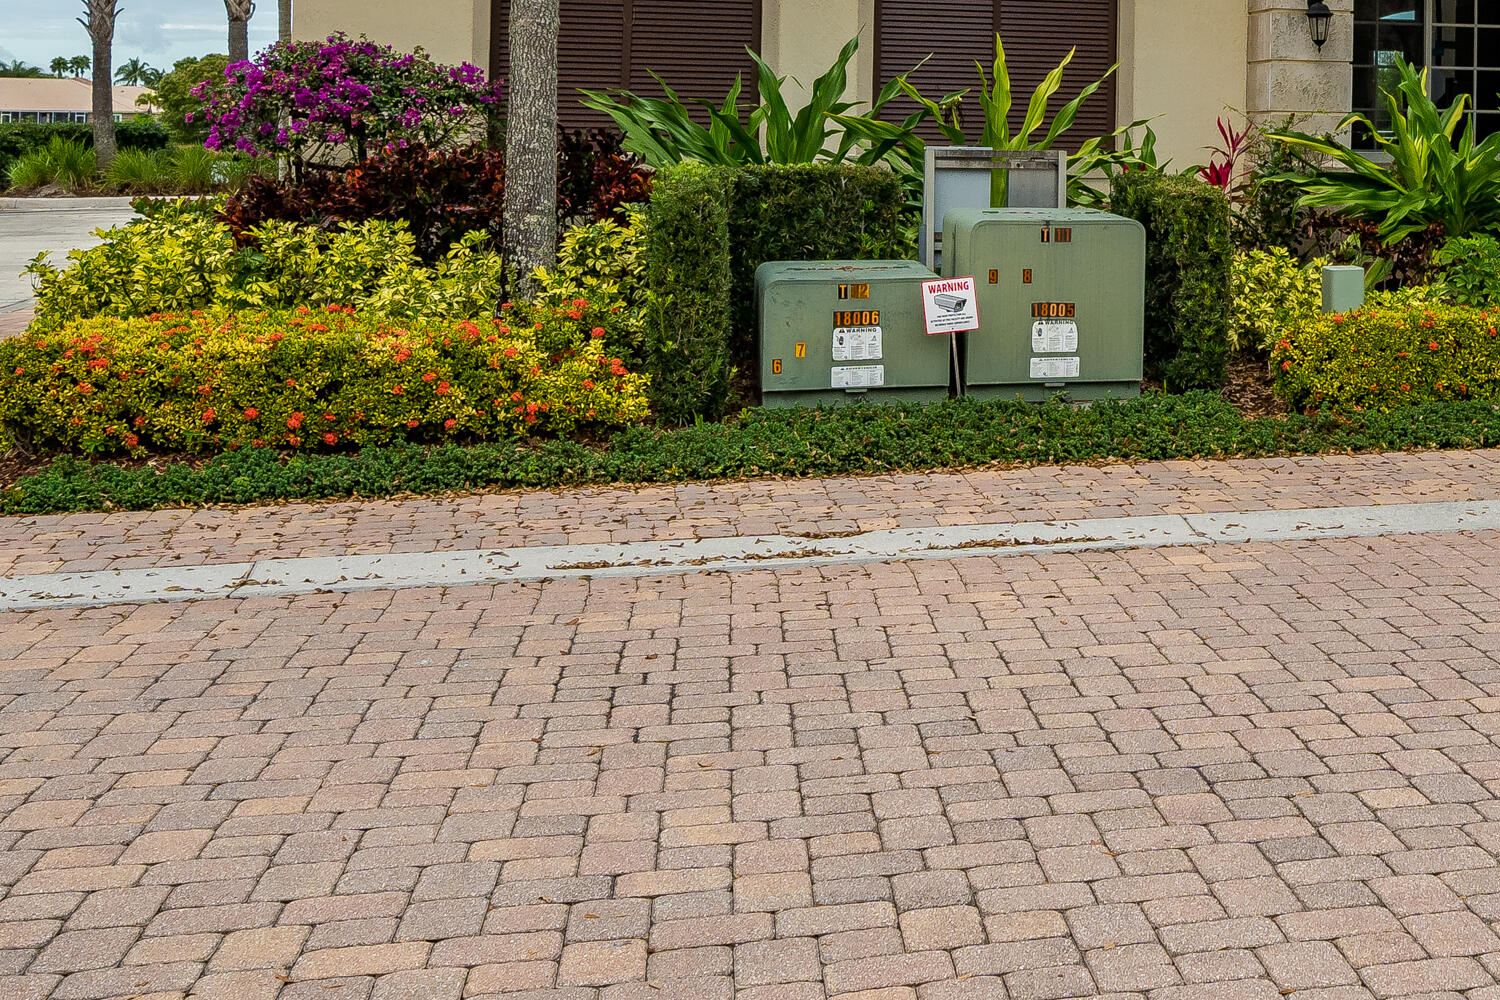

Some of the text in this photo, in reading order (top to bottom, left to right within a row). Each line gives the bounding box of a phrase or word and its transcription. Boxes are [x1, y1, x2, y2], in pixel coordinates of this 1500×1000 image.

[1041, 228, 1070, 242] T 11
[989, 270, 997, 284] 9
[1023, 269, 1031, 283] 8
[839, 284, 847, 299] T
[928, 281, 970, 294] WARNING
[1033, 303, 1074, 317] 18005
[834, 311, 879, 326] 18006
[797, 343, 805, 357] 7
[773, 359, 782, 373] 6
